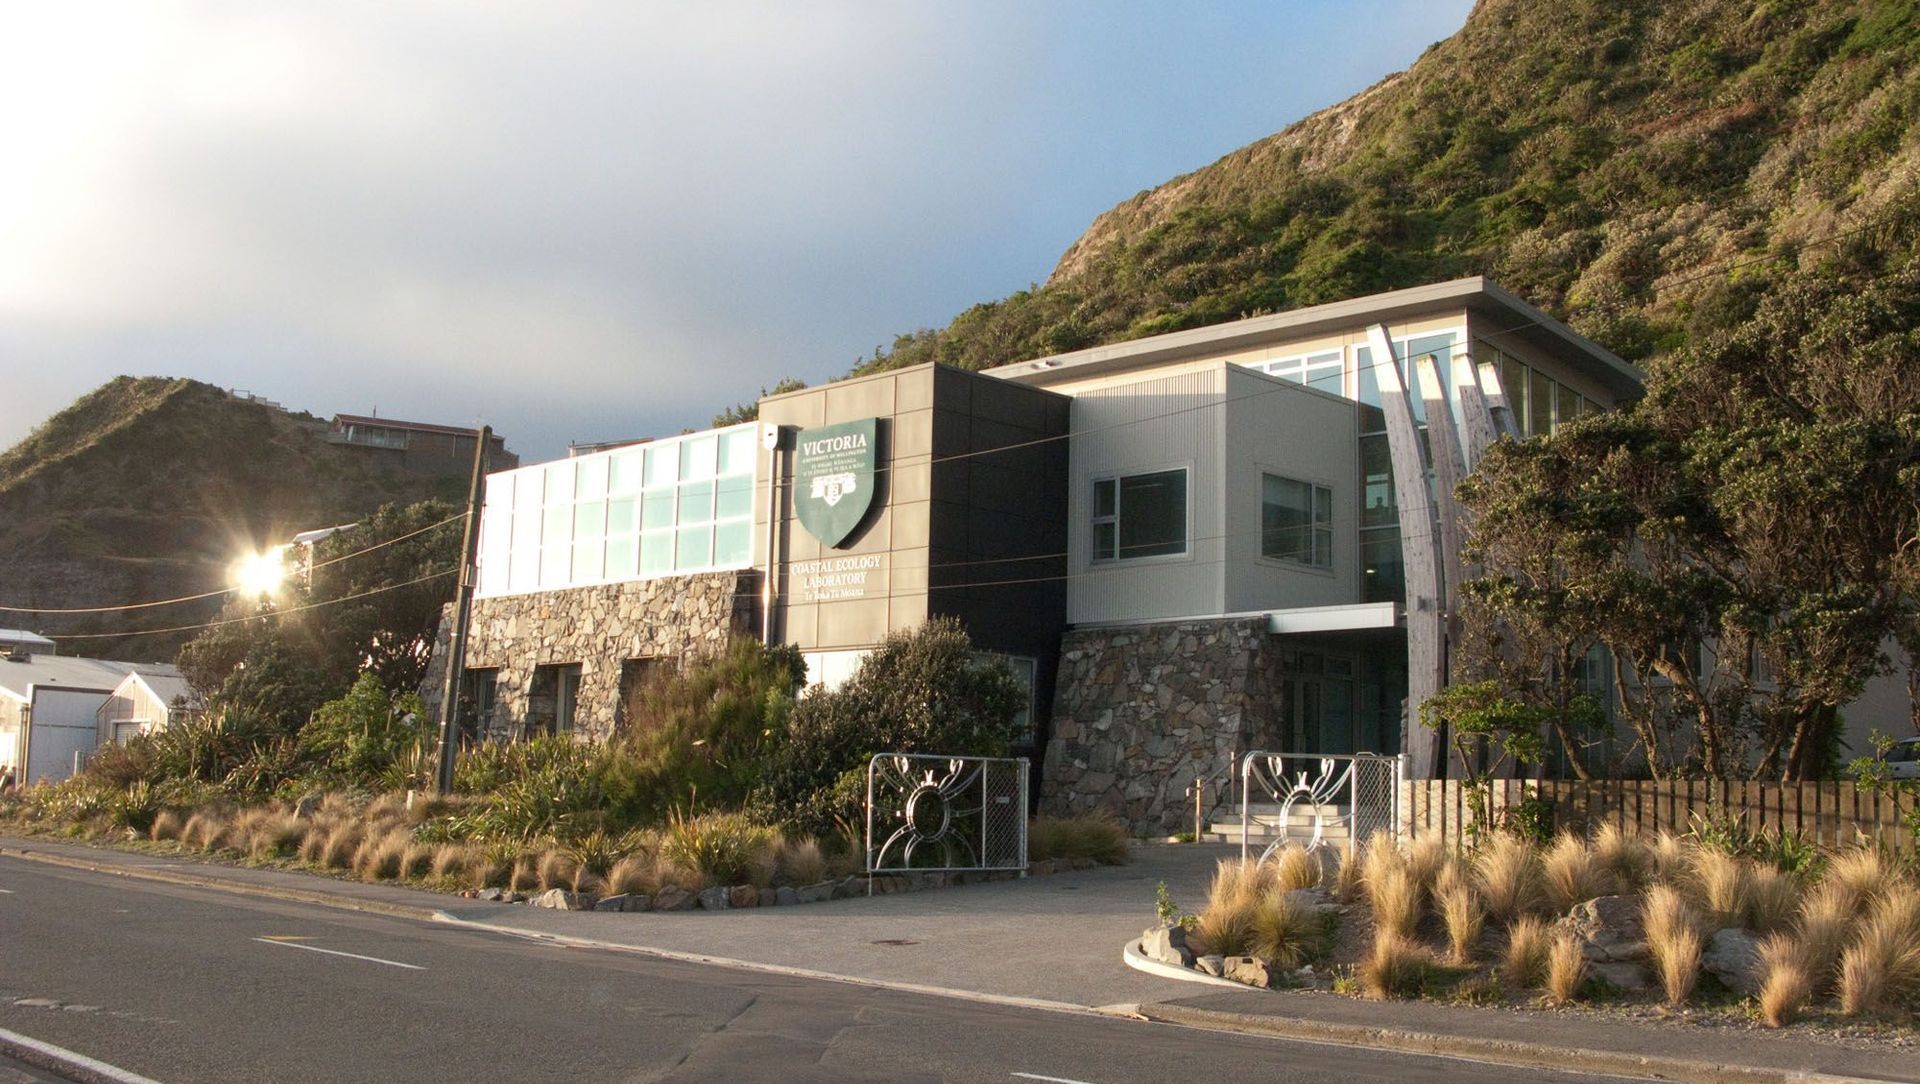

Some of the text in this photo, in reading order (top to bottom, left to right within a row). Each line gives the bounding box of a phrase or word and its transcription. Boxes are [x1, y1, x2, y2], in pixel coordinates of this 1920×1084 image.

[803, 433, 867, 456] VICTORIA
[791, 555, 881, 576] COASTAL ECOLOGY
[803, 571, 868, 589] LABORATORY
